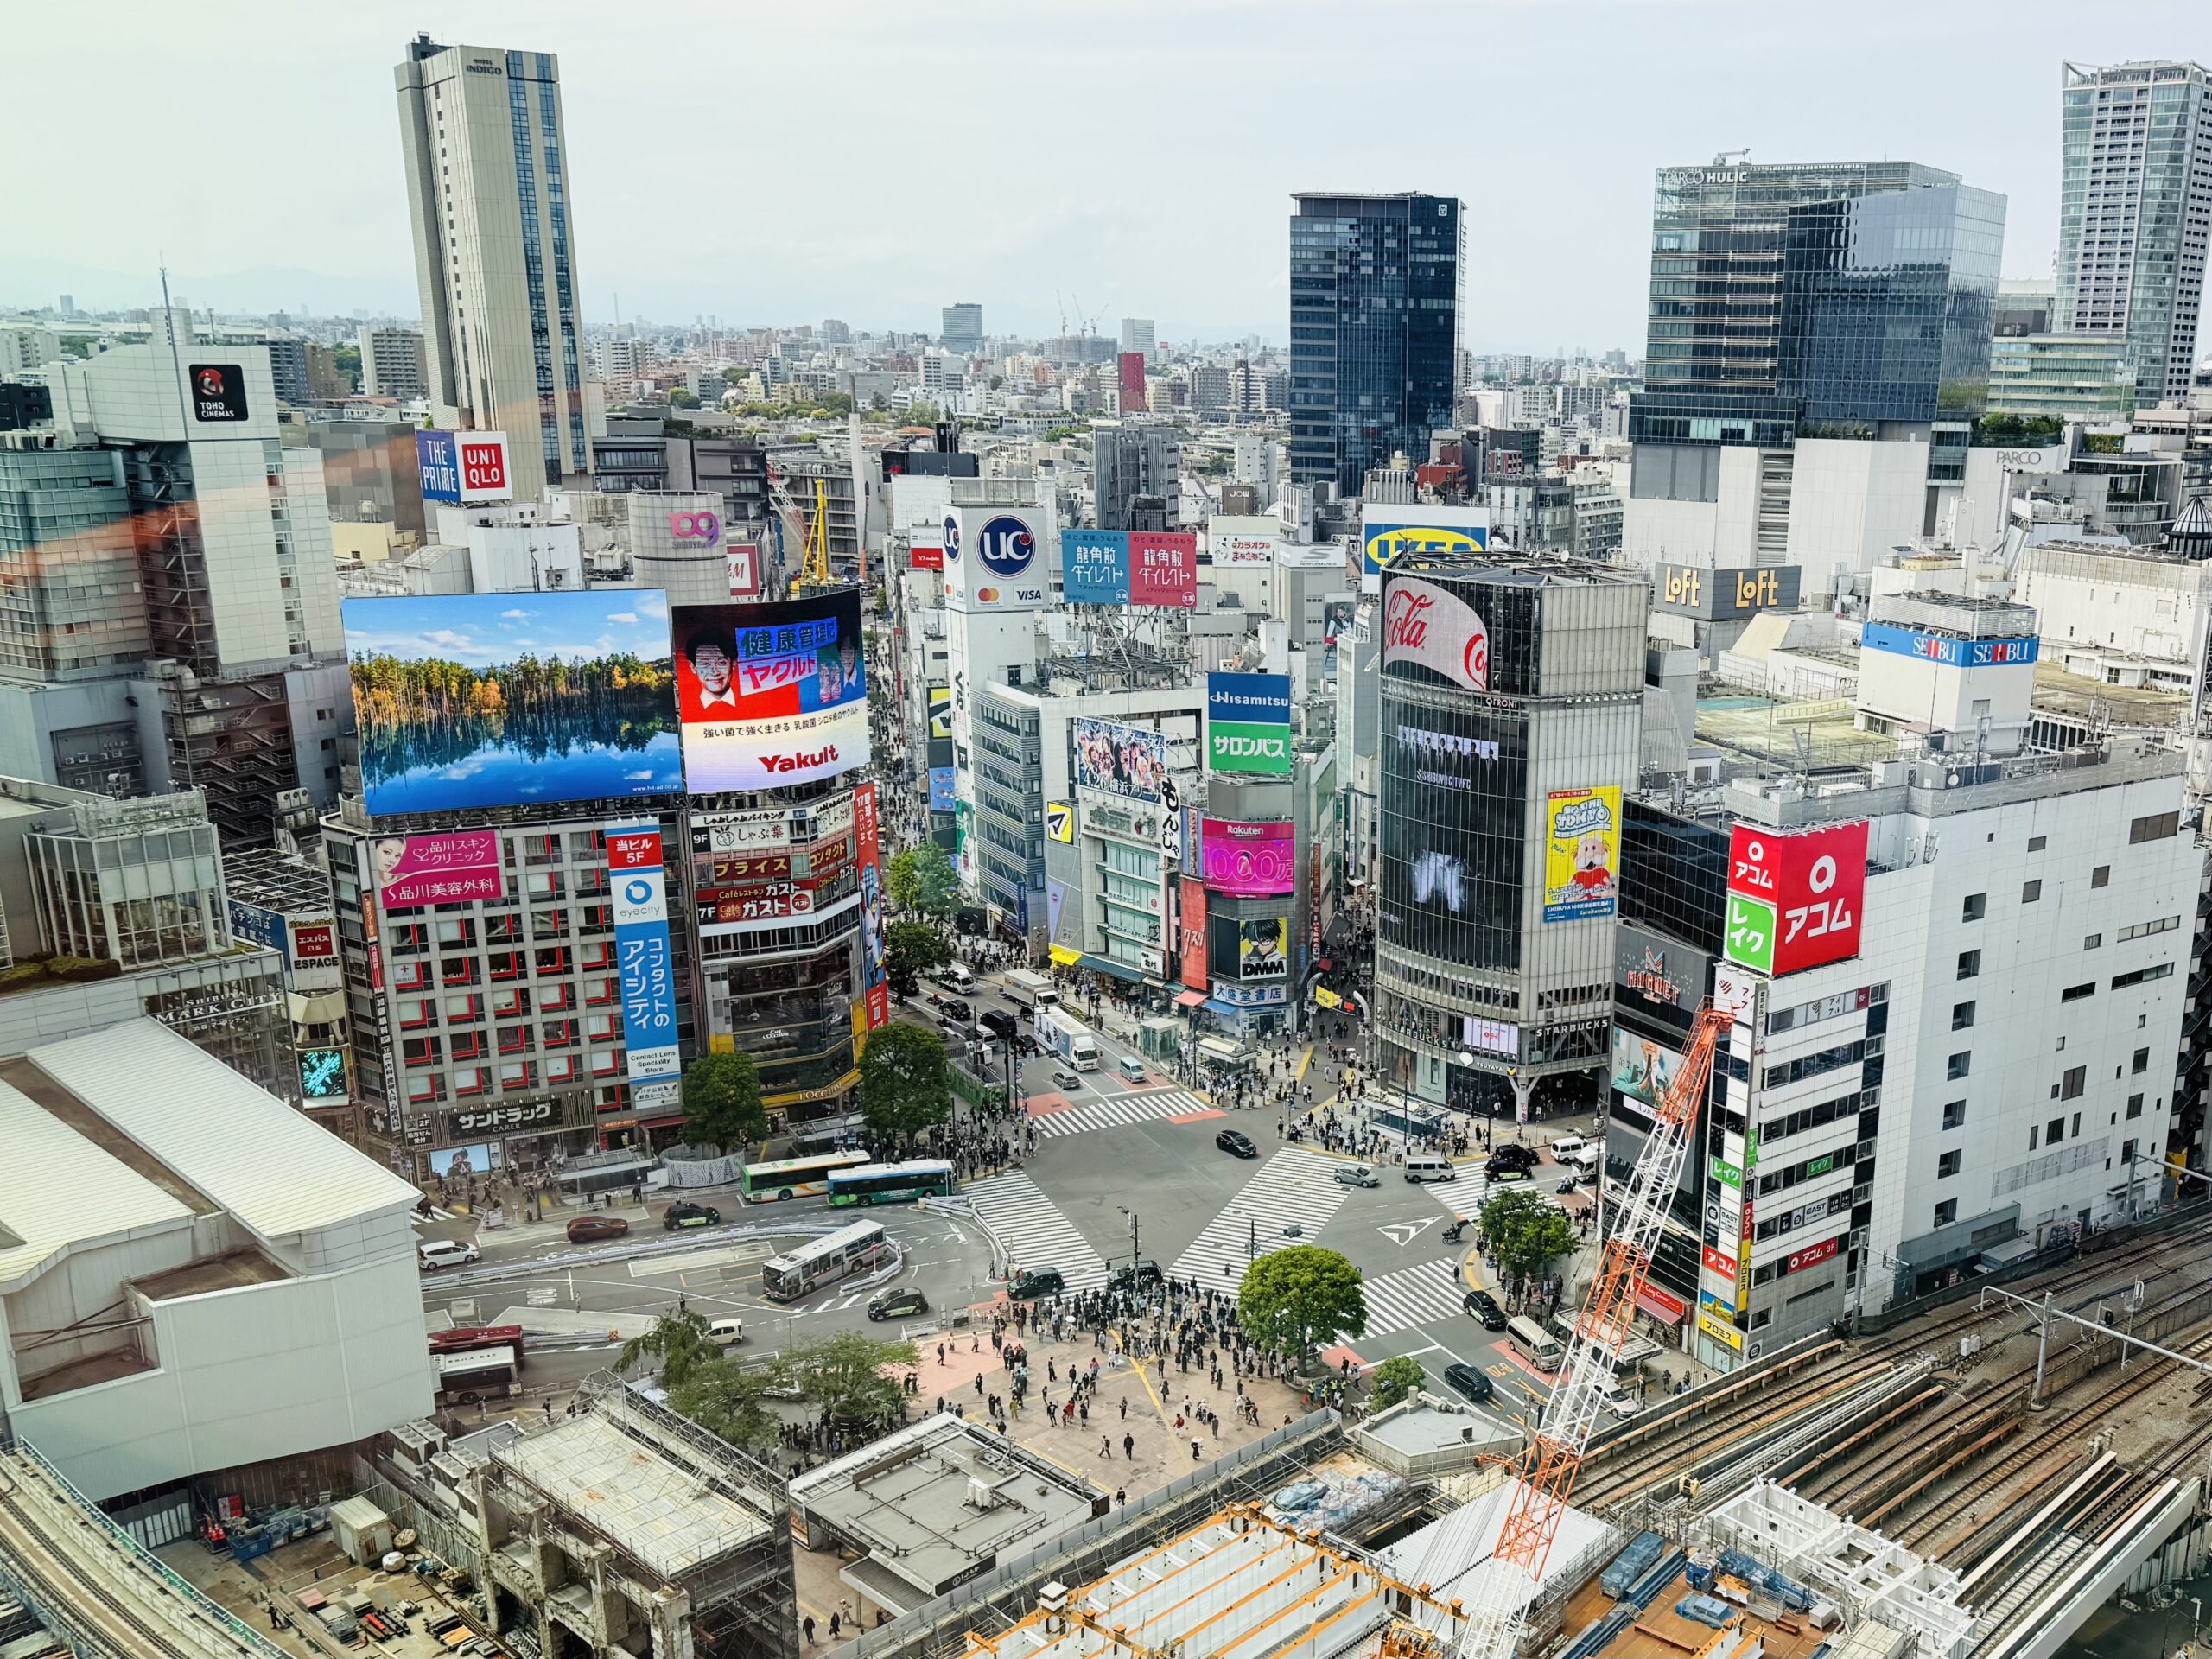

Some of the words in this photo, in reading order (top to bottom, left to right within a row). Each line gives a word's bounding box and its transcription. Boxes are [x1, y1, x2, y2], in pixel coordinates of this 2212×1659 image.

[467, 65, 502, 75] INDIGO
[1666, 171, 1704, 186] PARCO
[1707, 171, 1747, 183] HULIC
[426, 440, 448, 465] THE
[467, 449, 496, 465] UNI
[1996, 451, 2041, 465] PARCO
[423, 466, 456, 492] PRIME
[469, 467, 499, 486] QLO
[1076, 545, 1116, 564] 龍角散
[1144, 548, 1183, 568] 龍角散
[1071, 565, 1123, 584] ダイレクト
[1139, 567, 1190, 586] ダイレクト
[1016, 590, 1041, 601] VISA
[741, 620, 836, 658] 健康管理に
[1913, 636, 1956, 662] SEIBU
[1974, 642, 2029, 663] SEIBU
[743, 654, 816, 690] ヤクルト
[1210, 691, 1288, 706] Hisamitsu
[703, 723, 791, 738] 強い菌で強く生きる
[1214, 736, 1286, 759] サロンパス
[759, 744, 839, 773] Yakult
[1109, 779, 1162, 801] 横浜アリーナ
[703, 810, 785, 825] しゃぶしゃぶバイキング
[693, 834, 708, 844] 9F
[1227, 825, 1263, 835] Rakuten
[429, 837, 490, 852] 品川スキン
[615, 839, 652, 853] 当ビル
[431, 850, 485, 865] クリニック
[626, 852, 645, 864] 5F
[810, 842, 845, 868] コンタクト
[1735, 861, 1773, 889] アコム
[399, 878, 494, 900] 品川美容外科
[766, 882, 800, 896] ガスト
[620, 904, 661, 918] eyecity
[698, 907, 716, 918] 7F
[742, 900, 786, 918] ガスト
[1732, 902, 1747, 924] レ
[1785, 898, 1852, 944] アコム
[298, 934, 329, 944] エスパス
[1730, 927, 1764, 953] イク
[294, 957, 339, 969] ESPACE
[1242, 961, 1285, 976] DMM
[622, 940, 647, 1029] アイシティ
[648, 938, 671, 1027] コンタクトの
[1627, 970, 1681, 1006] MAGNET
[186, 991, 245, 1006] SHIBUYA
[1217, 985, 1281, 1001] 大盛堂書店
[156, 1005, 220, 1022] MARK
[230, 992, 281, 1009] CITY
[1389, 1020, 1447, 1048] STARBUCKS
[1536, 1019, 1608, 1037] STARBUCKS
[631, 1052, 658, 1062] Contact
[659, 1050, 676, 1058] Lens
[637, 1058, 671, 1068] Speciality
[1477, 1062, 1503, 1072] TSUTAYA
[459, 1103, 551, 1129] サンドラッグ
[1713, 1161, 1738, 1179] レイク
[1810, 1160, 1827, 1172] レイク
[1802, 1248, 1823, 1263] アコム
[1827, 1243, 1835, 1253] 3F
[1707, 1252, 1735, 1274] アコム
[1706, 1320, 1732, 1342] プロミス
